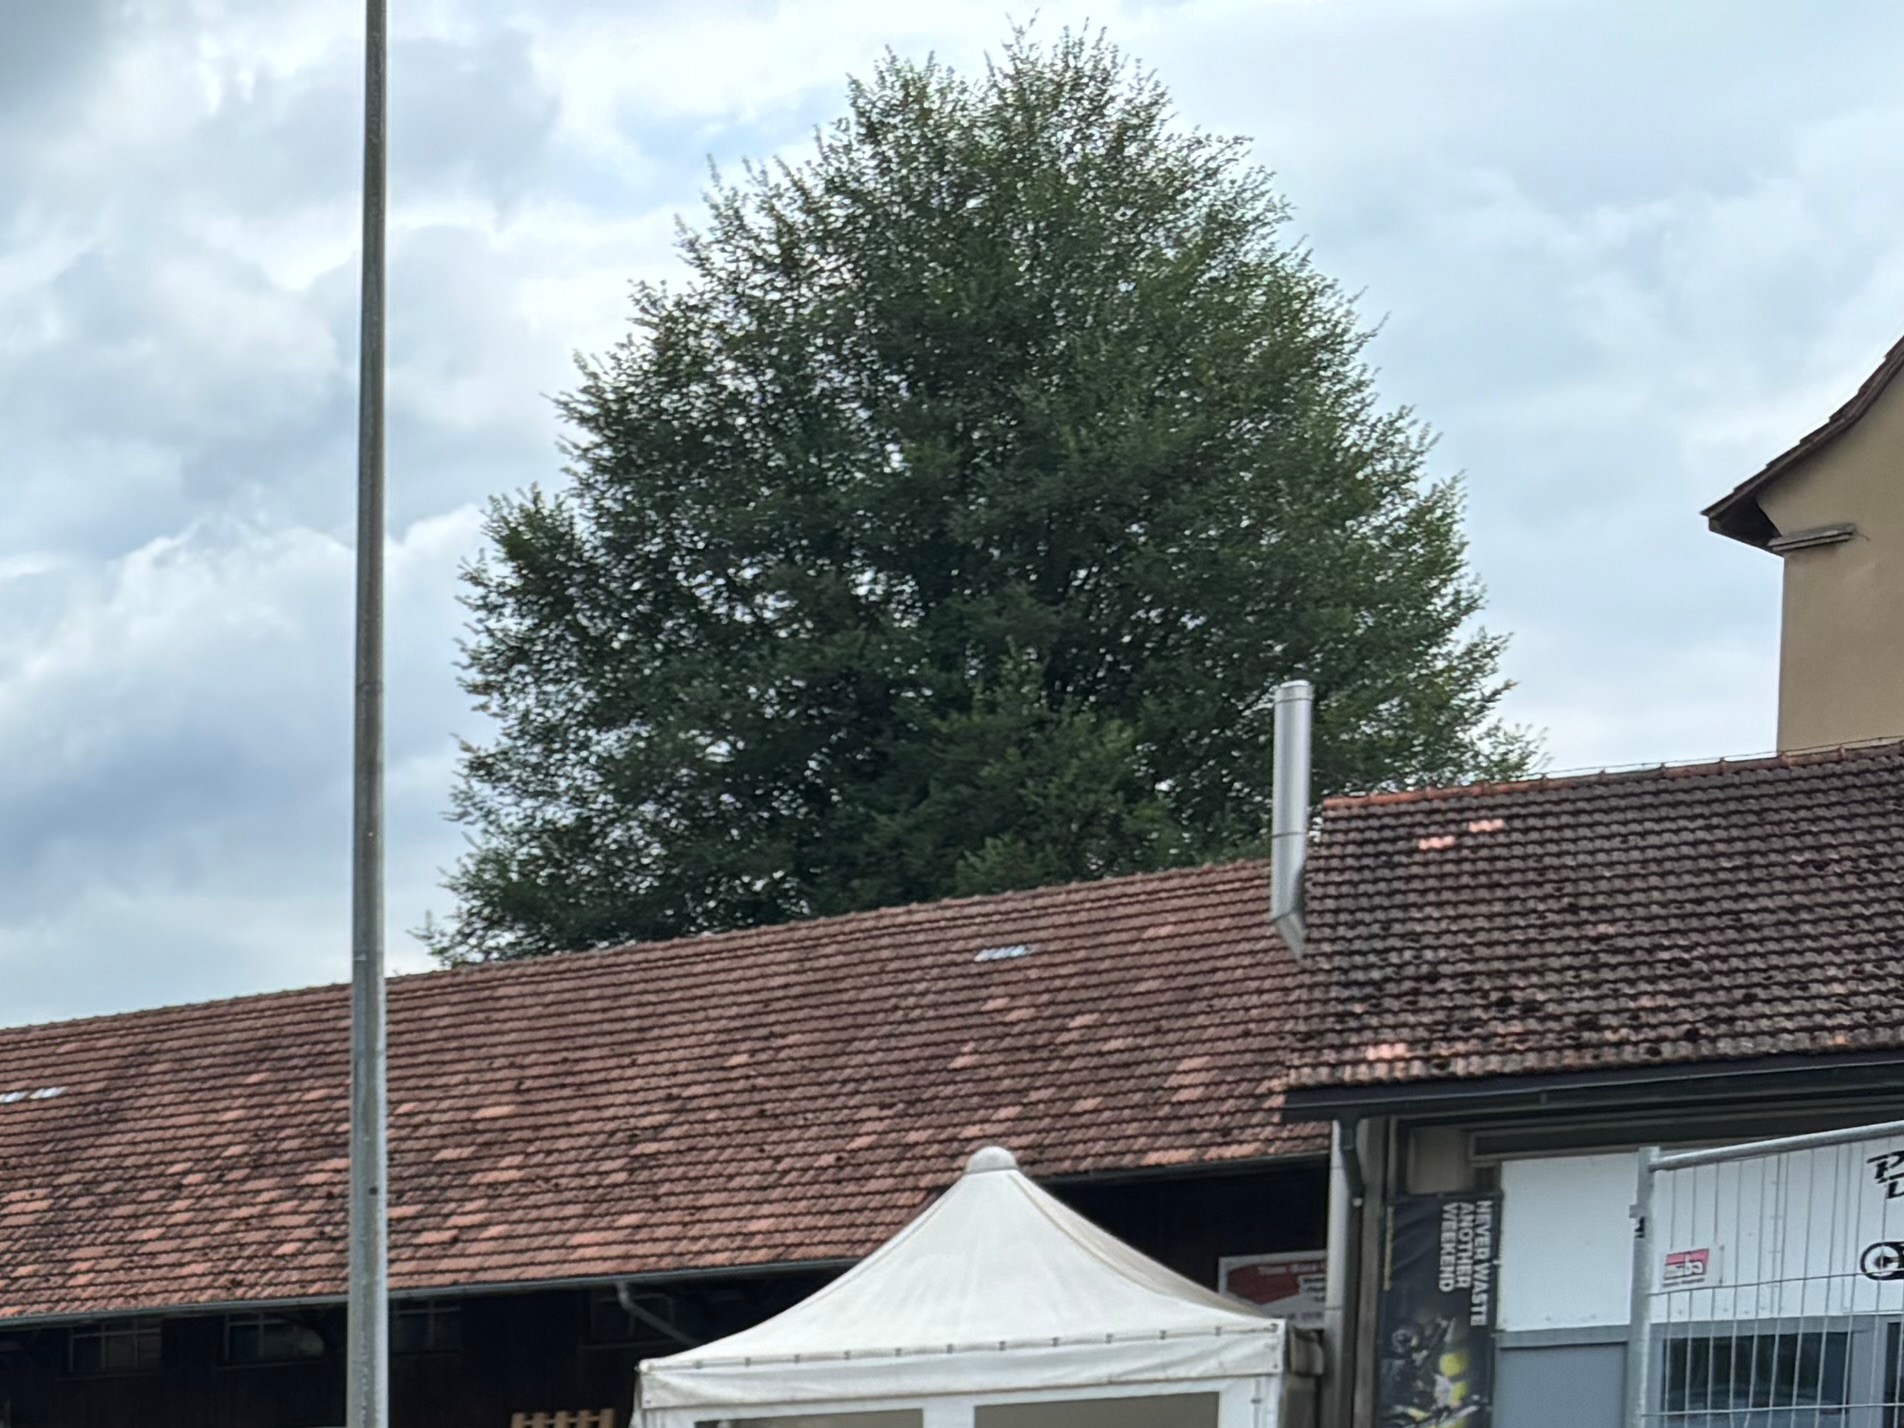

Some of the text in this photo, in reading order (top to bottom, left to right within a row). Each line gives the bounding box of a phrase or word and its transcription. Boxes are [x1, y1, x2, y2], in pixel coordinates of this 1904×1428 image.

[1438, 1202, 1459, 1292] WEEKEND
[1455, 1202, 1474, 1288] ANOTHER
[1470, 1200, 1492, 1326] NEVER WASTE
